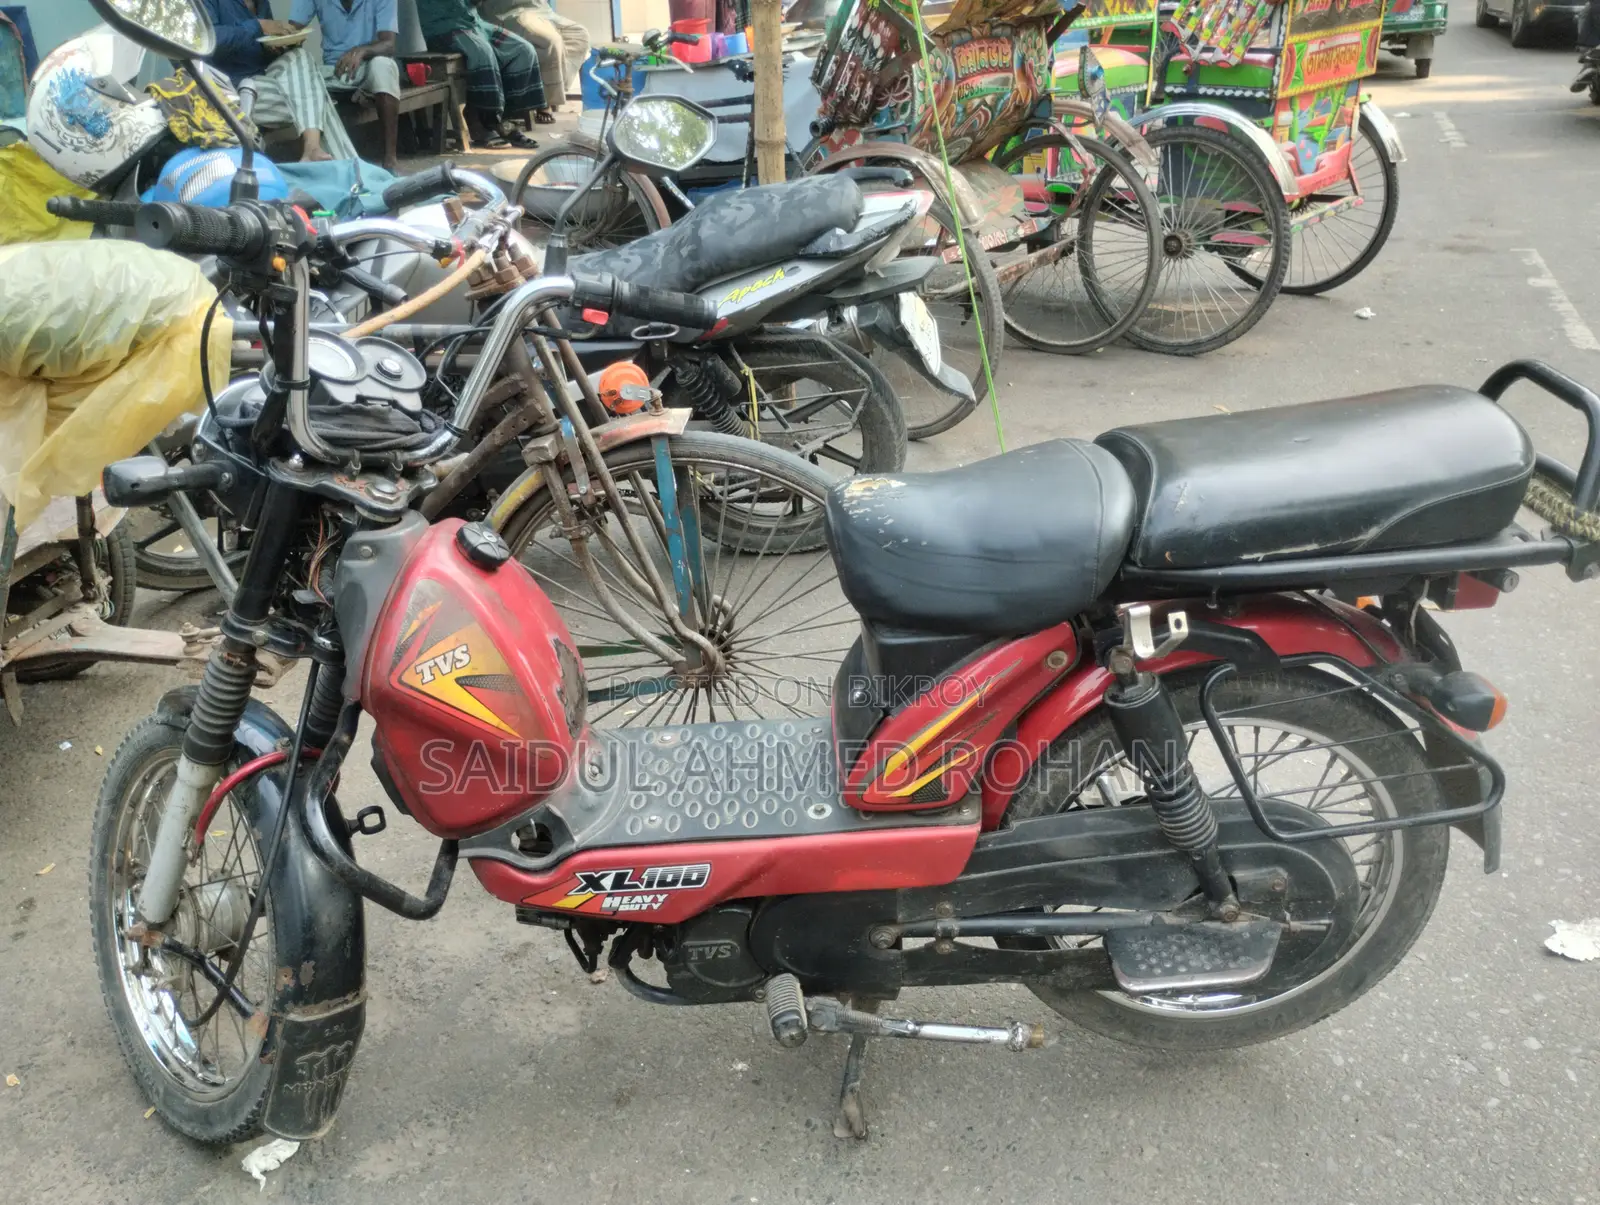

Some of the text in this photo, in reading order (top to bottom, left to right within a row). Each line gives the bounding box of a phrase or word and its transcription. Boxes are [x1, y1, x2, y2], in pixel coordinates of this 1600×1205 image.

[415, 644, 472, 685] TVS
[601, 893, 669, 908] HEAVY
[618, 902, 663, 911] DUTY
[687, 944, 734, 961] TVS
